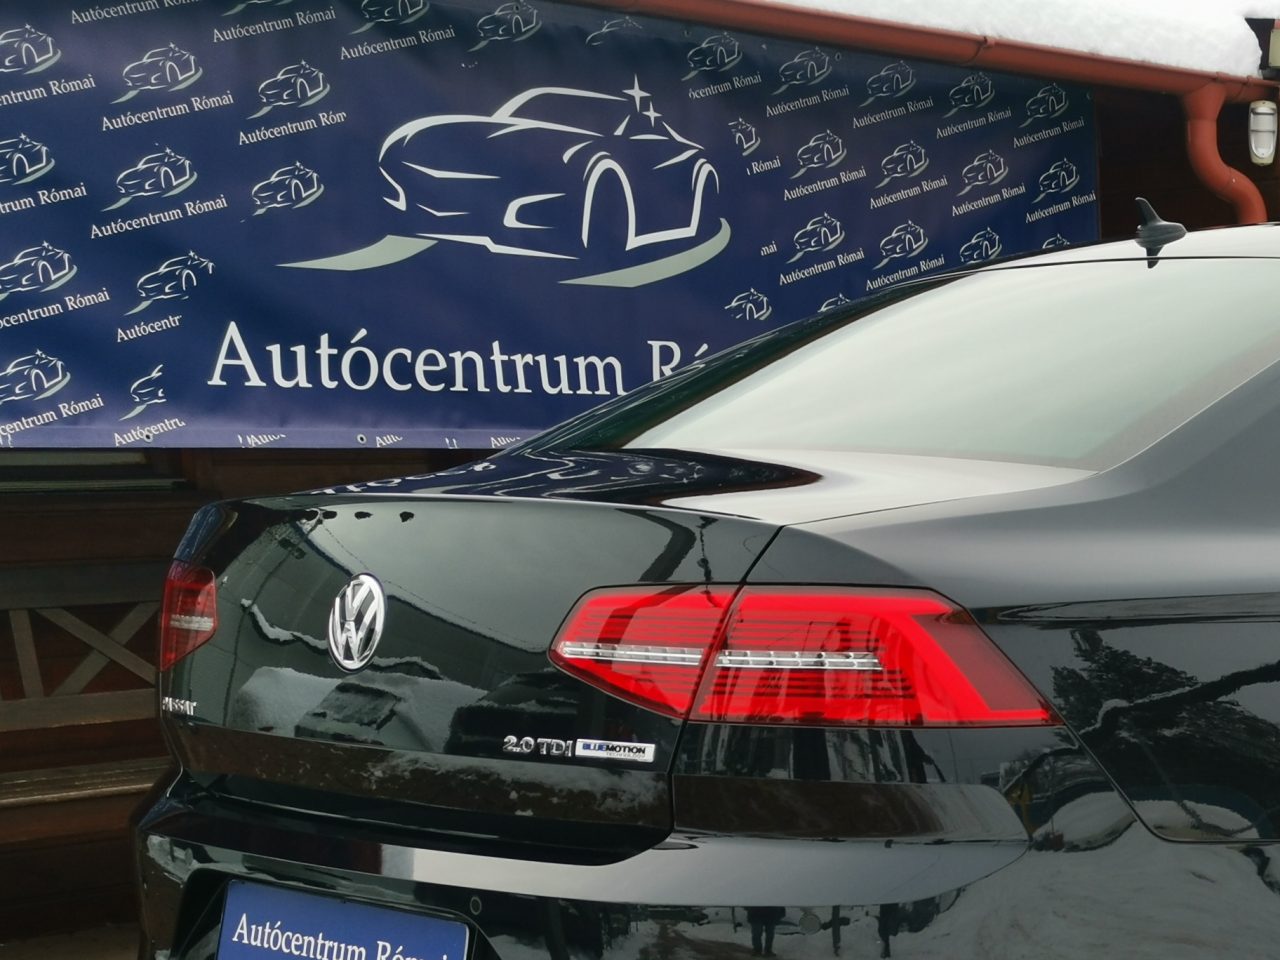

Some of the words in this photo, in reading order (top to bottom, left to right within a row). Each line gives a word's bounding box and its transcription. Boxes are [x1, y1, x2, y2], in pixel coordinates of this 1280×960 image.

[71, 0, 160, 24] Autócentrum
[213, 16, 294, 43] Autócentrum
[296, 6, 336, 27] Római
[340, 34, 418, 60] Autócentrum
[418, 25, 456, 44] Római
[48, 74, 96, 95] Római
[733, 71, 762, 89] Római
[102, 102, 190, 131] Autócentrum
[191, 90, 234, 113] Római
[766, 95, 822, 117] Autócentrum
[821, 84, 850, 102] Római
[853, 105, 907, 129] Autócentrum
[907, 96, 934, 113] Római
[238, 118, 318, 145] Autócentrum
[936, 116, 987, 139] Autócentrum
[988, 106, 1012, 123] Római
[1013, 126, 1062, 149] Autócentrum
[1062, 117, 1085, 133] Római
[752, 155, 781, 174] Római
[37, 182, 88, 205] Római
[784, 177, 840, 201] Autócentrum
[840, 166, 867, 184] Római
[870, 186, 921, 210] Autócentrum
[922, 175, 948, 193] Római
[952, 193, 1001, 217] Autócentrum
[1002, 182, 1026, 200] Római
[91, 207, 183, 239] Autócentrum
[184, 194, 228, 217] Római
[1025, 200, 1071, 224] Autócentrum
[1072, 189, 1097, 207] Római
[779, 260, 836, 286] Autócentrum
[837, 248, 865, 265] Római
[866, 265, 919, 291] Autócentrum
[919, 253, 945, 273] Római
[64, 287, 110, 311] Római
[207, 320, 629, 396] Autócentrum
[647, 340, 709, 382] R
[58, 393, 104, 418] Római
[536, 737, 574, 757] TDI
